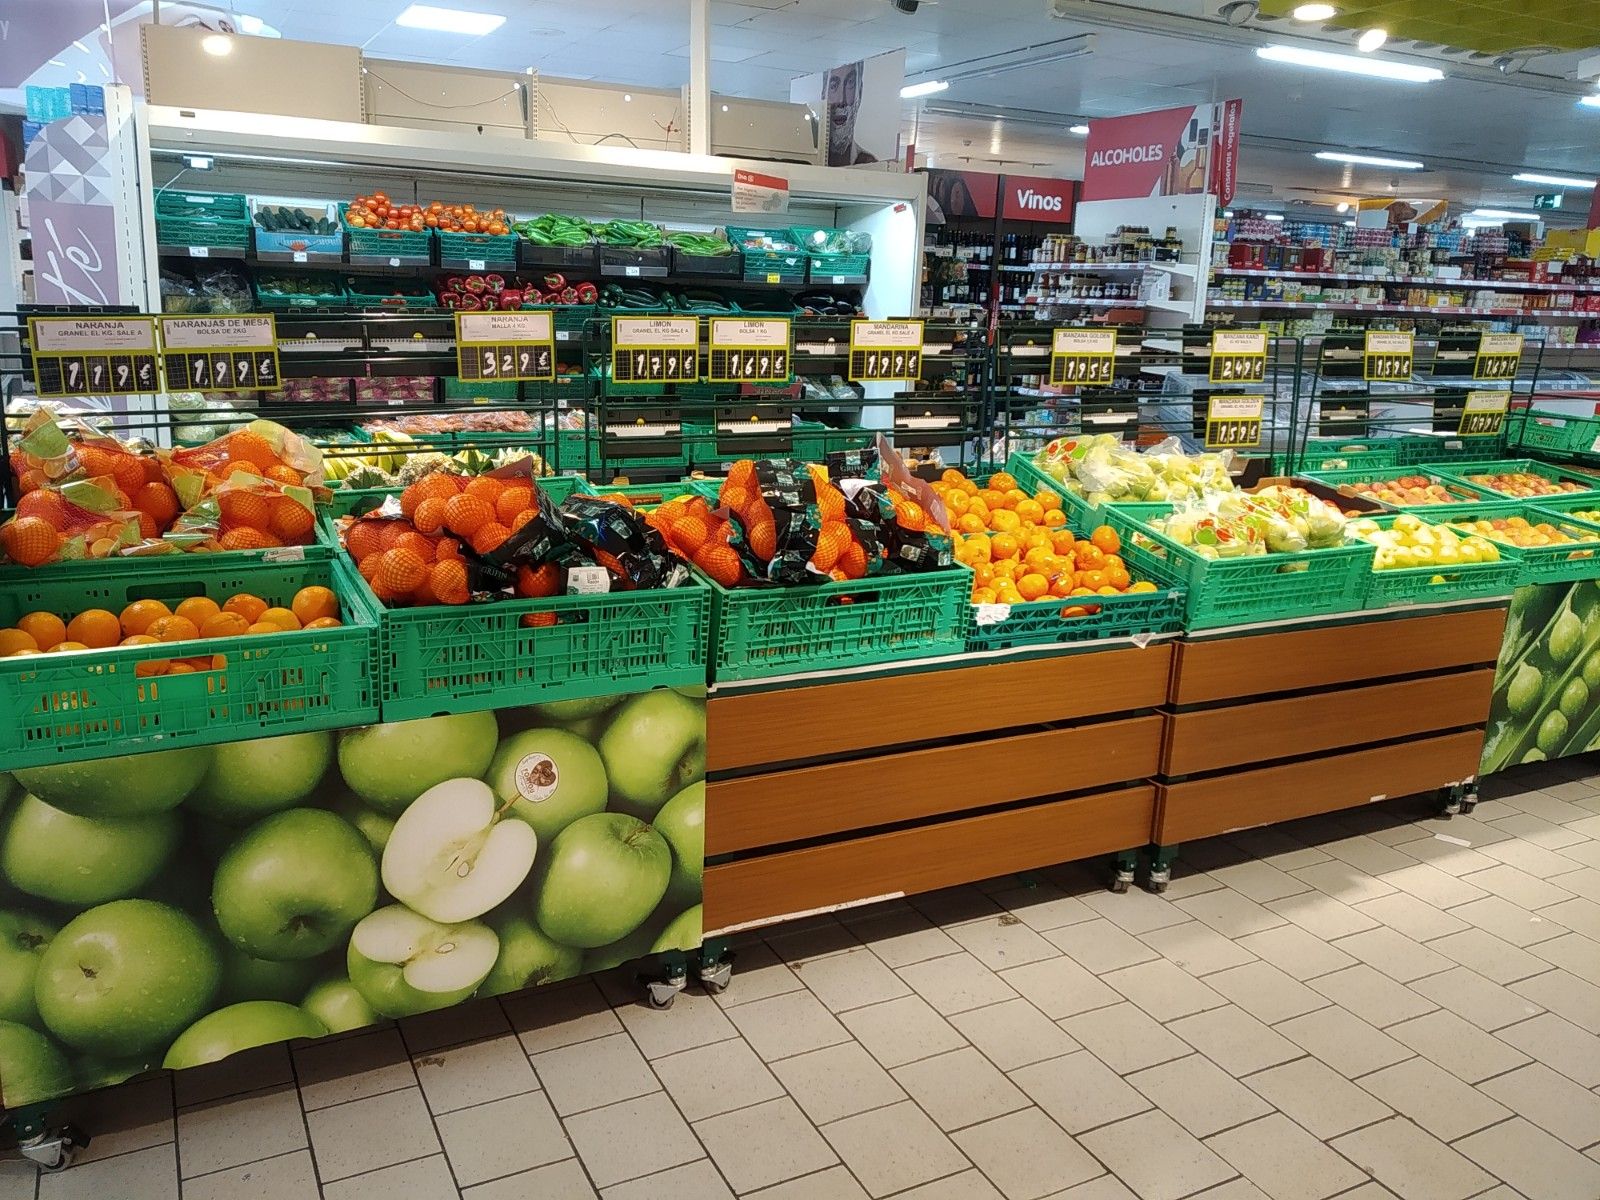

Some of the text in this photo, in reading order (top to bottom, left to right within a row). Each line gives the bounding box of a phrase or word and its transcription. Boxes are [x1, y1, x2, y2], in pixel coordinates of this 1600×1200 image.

[1090, 144, 1163, 168] ALCOHOLES
[1223, 102, 1238, 202] Conservas vegetales
[1016, 189, 1062, 211] Vinos
[75, 321, 125, 329] NARANJA
[173, 318, 270, 329] NARANJAS DE MESA
